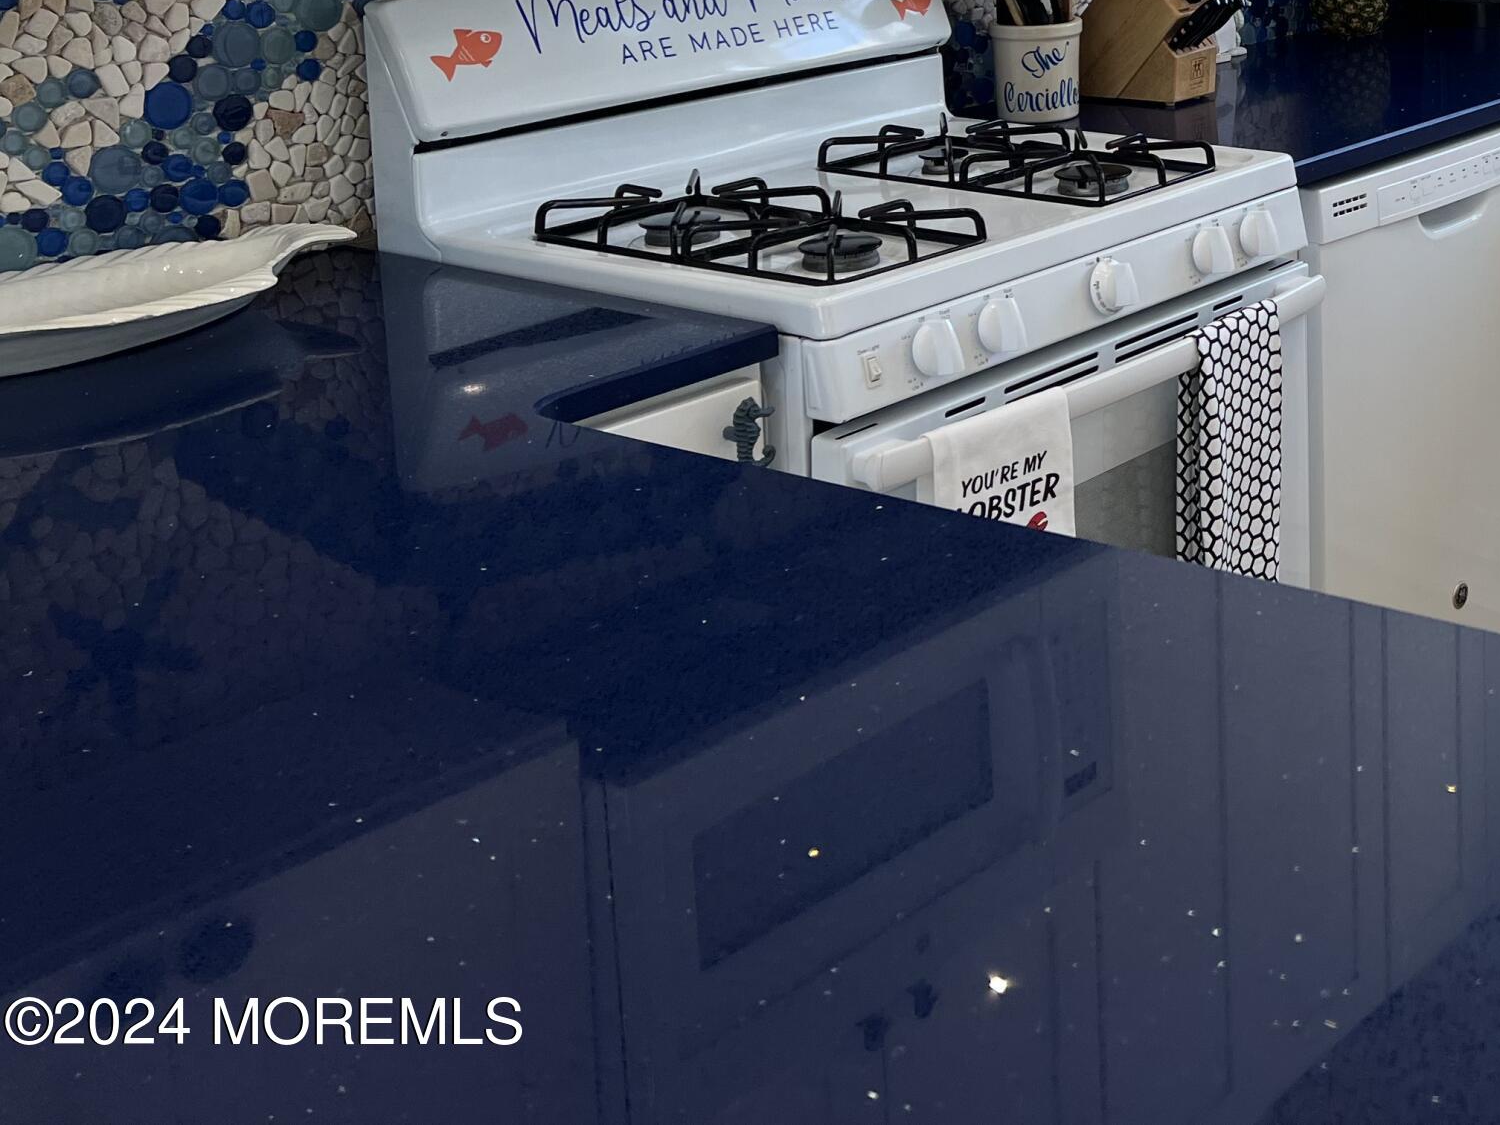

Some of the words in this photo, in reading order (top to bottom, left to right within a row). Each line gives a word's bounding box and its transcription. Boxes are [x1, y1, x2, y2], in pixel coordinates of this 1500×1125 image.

[621, 35, 678, 65] ARE
[689, 22, 766, 53] MADE
[777, 10, 841, 38] HERE
[1021, 40, 1070, 79] The
[956, 472, 1060, 521] OBSTER
[961, 460, 1020, 499] YOU'RE
[1023, 449, 1049, 476] MY
